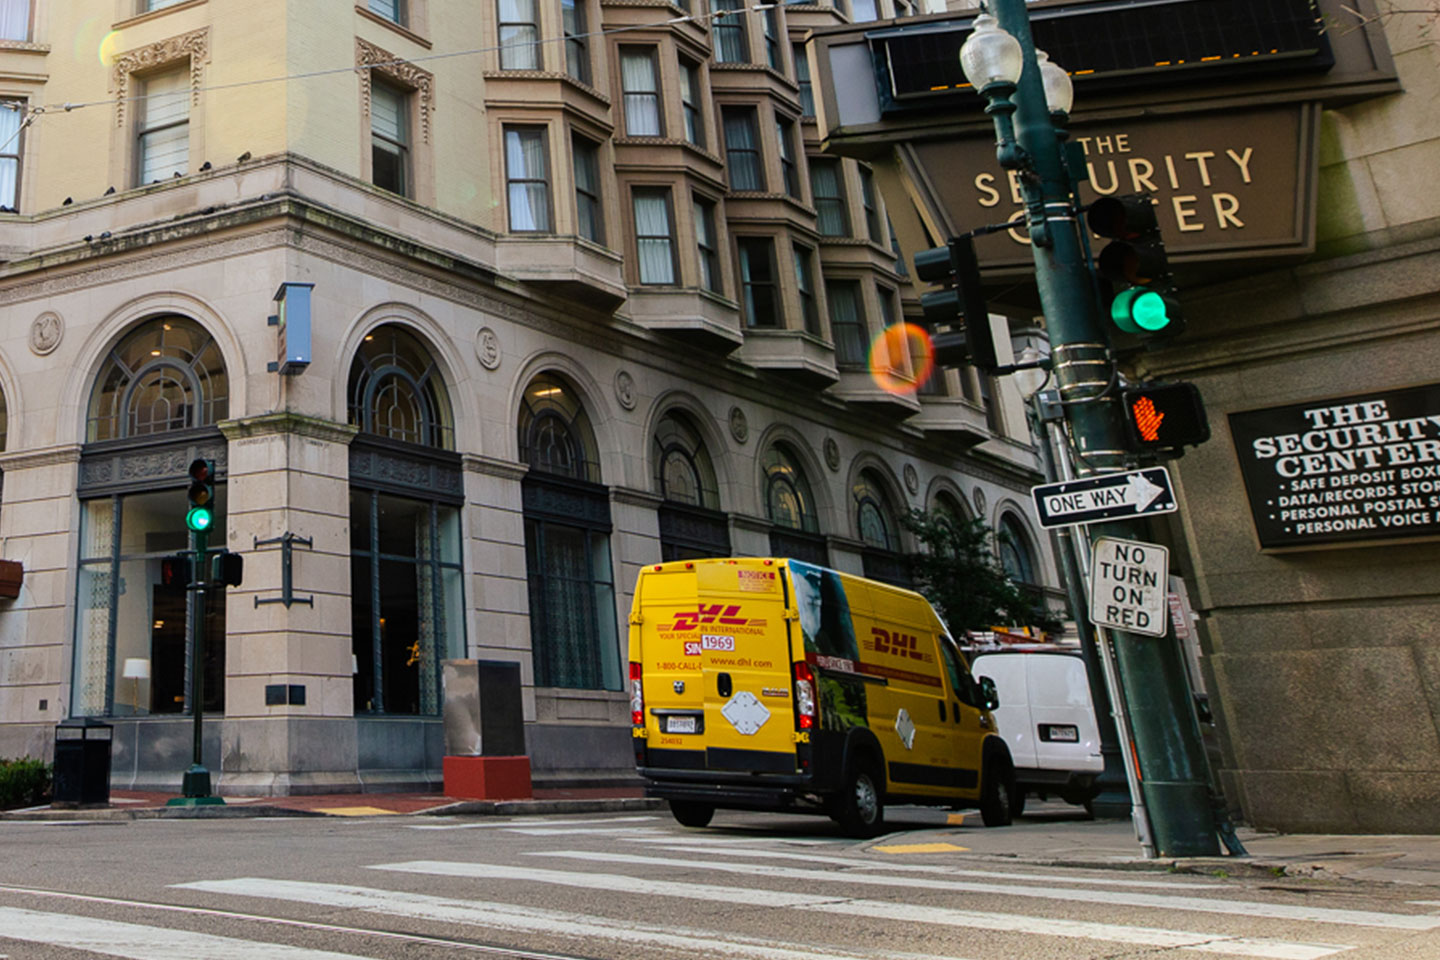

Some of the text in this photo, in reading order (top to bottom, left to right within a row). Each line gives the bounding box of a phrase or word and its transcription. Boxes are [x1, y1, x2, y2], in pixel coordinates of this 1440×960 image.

[1077, 134, 1131, 155] THE
[974, 147, 1253, 208] SEURITY
[1304, 400, 1390, 429] THE
[1275, 440, 1440, 478] CENTER
[1291, 477, 1326, 492] SAFE
[1330, 469, 1396, 488] DEPOSIT
[1049, 486, 1127, 514] ONE WAY
[1278, 484, 1397, 507] DATA/RECORDS
[1281, 503, 1360, 522] PERSONAL
[1363, 498, 1426, 515] POSTAL
[1296, 517, 1377, 535] PERSONAL
[1380, 512, 1431, 527] VOICE
[1115, 544, 1145, 564] NO
[1100, 562, 1157, 588] TURN
[1113, 585, 1143, 606] ON
[672, 603, 748, 631] DHL
[1107, 605, 1150, 628] RED
[704, 636, 733, 650] 1969
[710, 626, 765, 637] INTERNATIONAL
[872, 627, 923, 661] DHL
